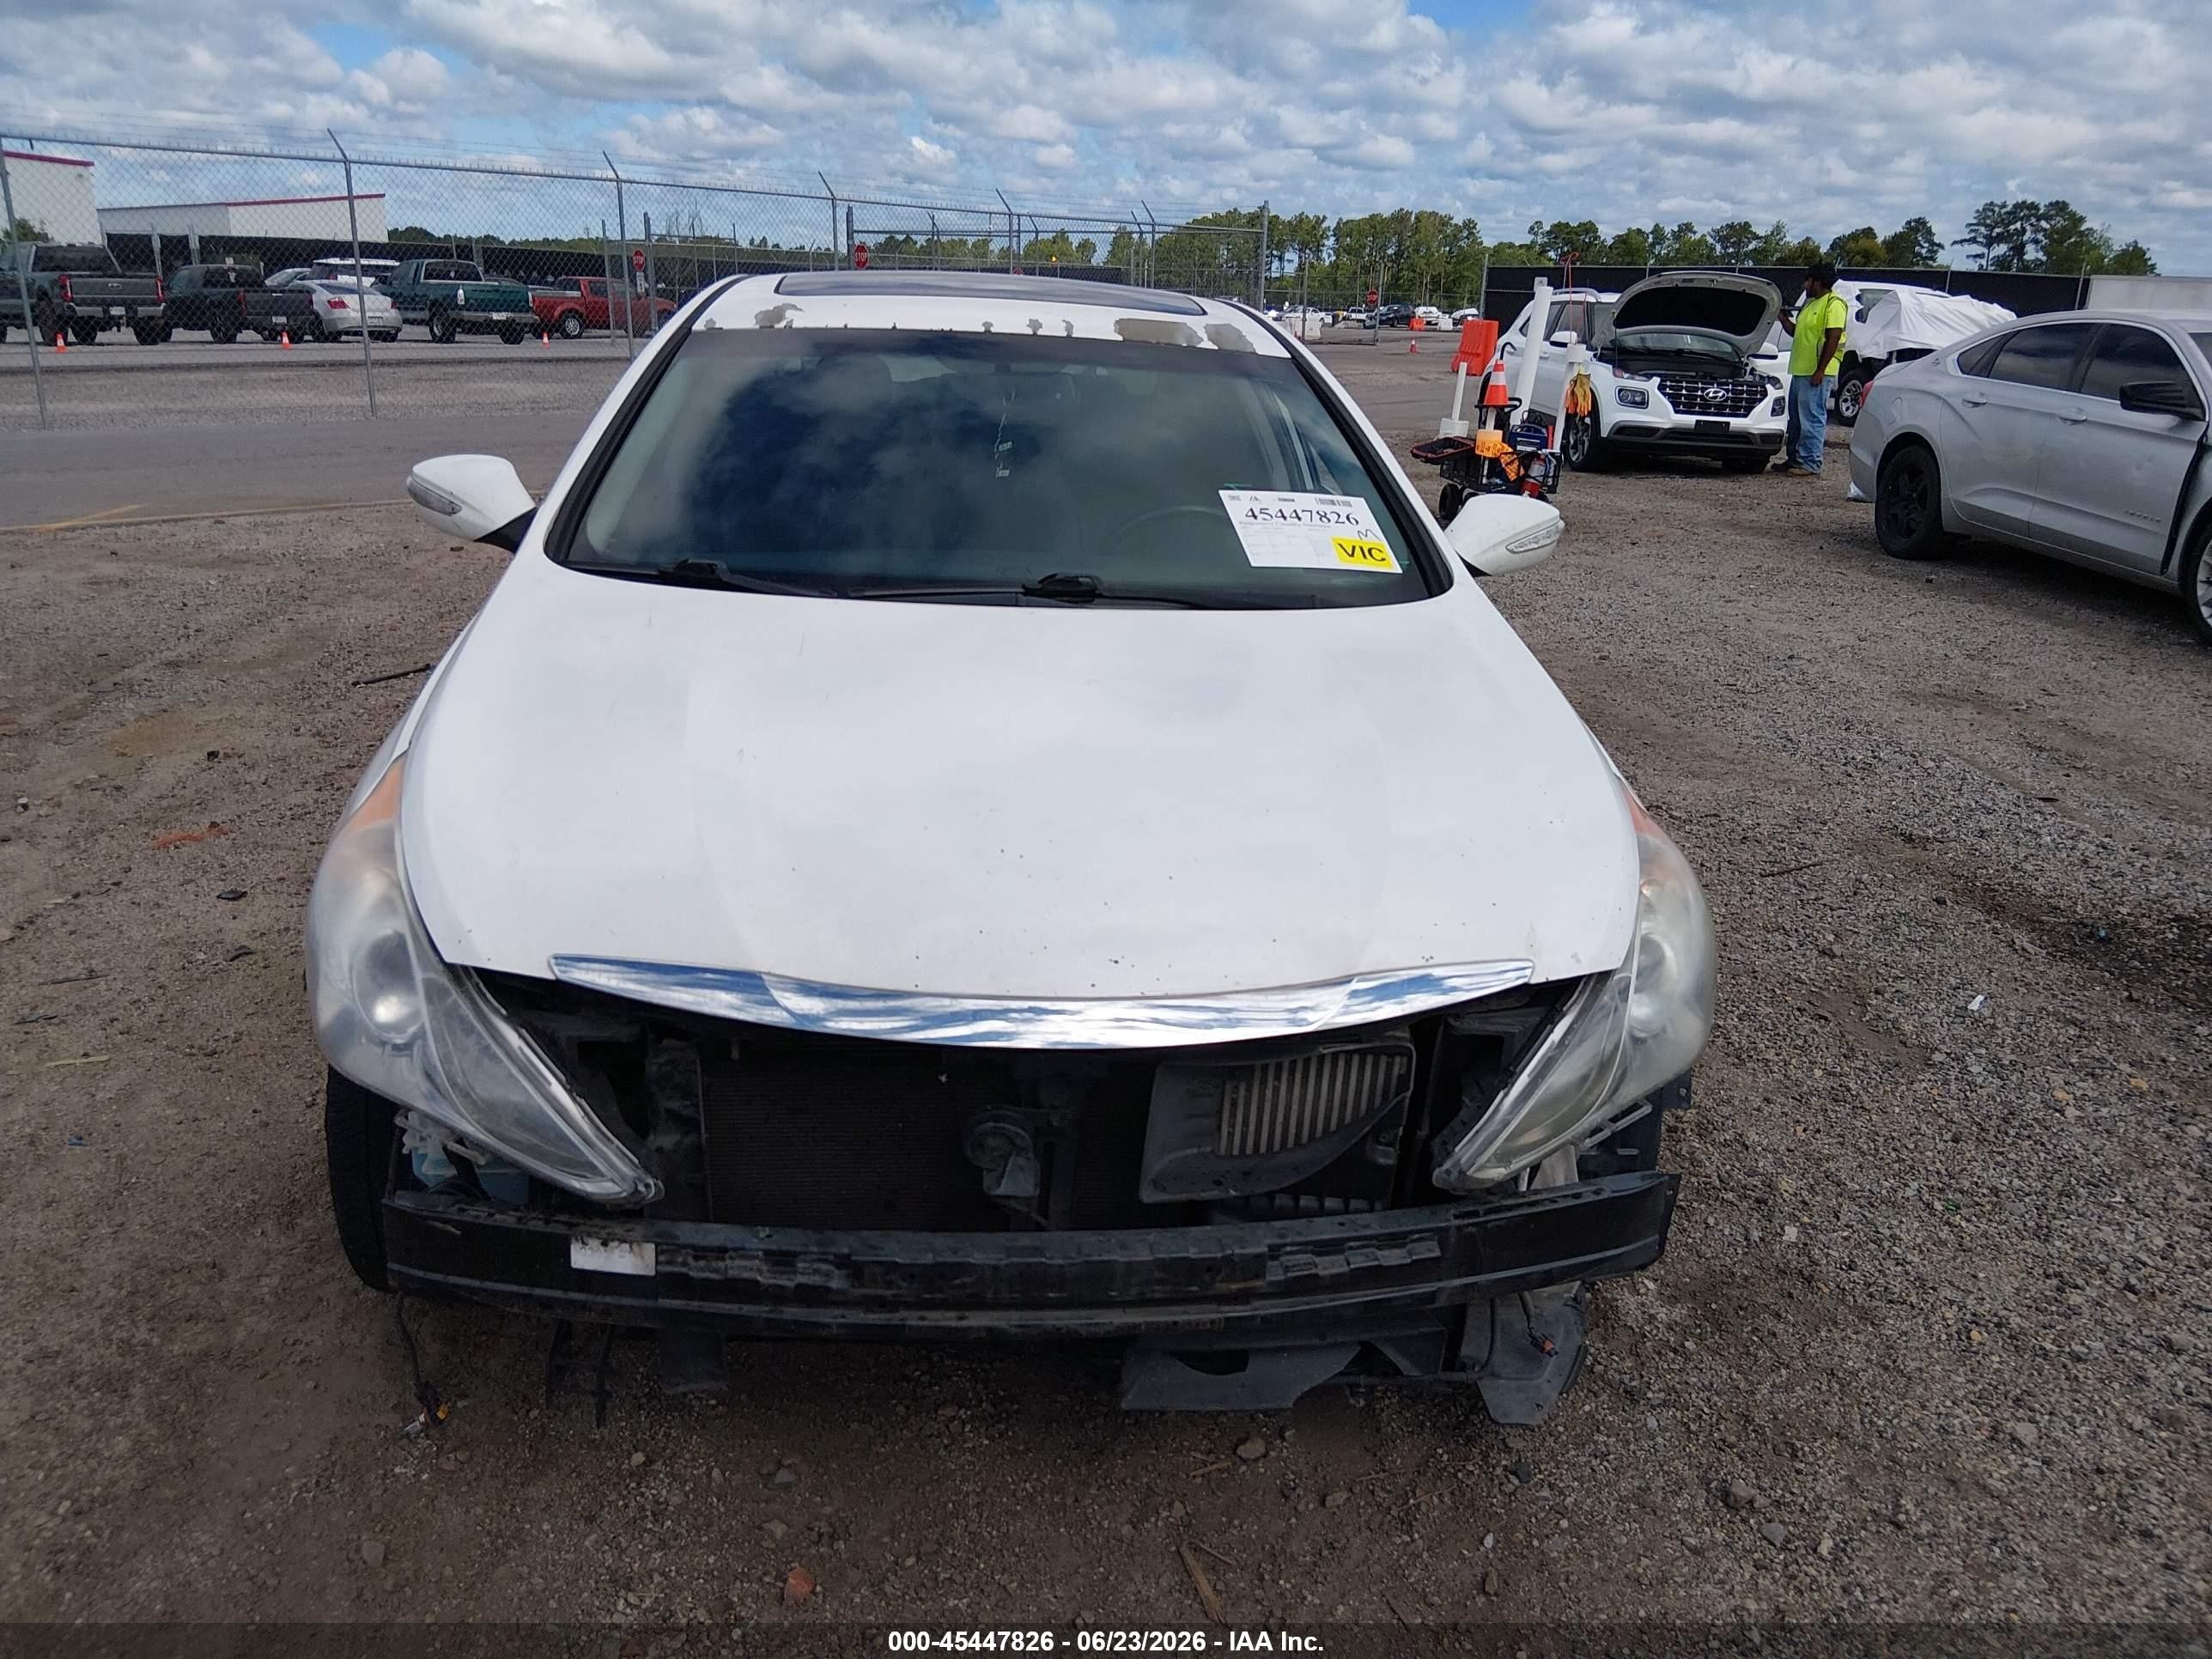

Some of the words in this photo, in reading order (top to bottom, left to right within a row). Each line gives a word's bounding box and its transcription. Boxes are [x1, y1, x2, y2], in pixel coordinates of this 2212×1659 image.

[855, 252, 867, 262] STOP
[1245, 507, 1359, 526] 45447826
[1336, 542, 1388, 562] VIC
